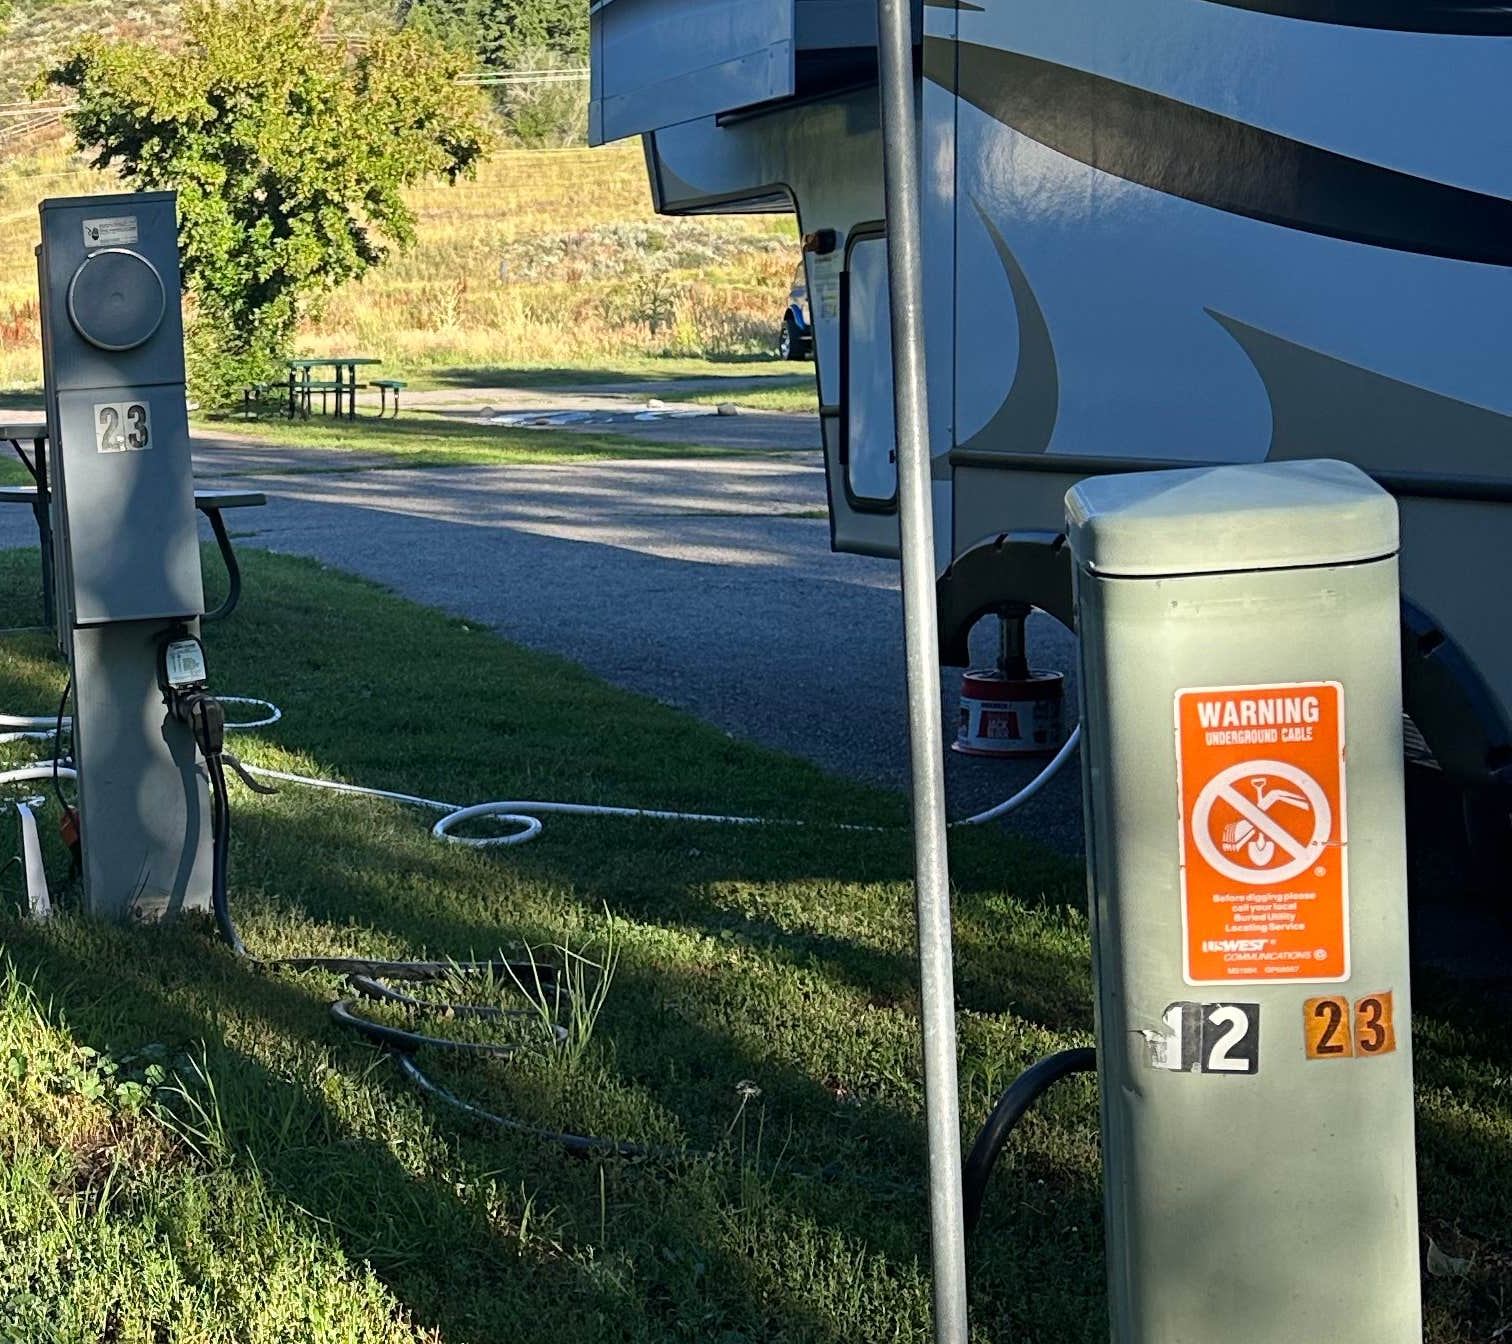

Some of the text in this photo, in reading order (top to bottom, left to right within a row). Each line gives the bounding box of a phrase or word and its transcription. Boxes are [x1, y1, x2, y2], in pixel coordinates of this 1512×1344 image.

[99, 404, 149, 452] 23
[1197, 696, 1320, 728] WARNING
[1205, 726, 1313, 746] UNDERGROUND CABLE
[1212, 892, 1316, 903] Before digging please
[1232, 902, 1297, 913] call your local
[1225, 922, 1305, 933] Locating Service
[1224, 951, 1313, 962] COMMUNICATIONS
[1313, 1000, 1386, 1055] 23
